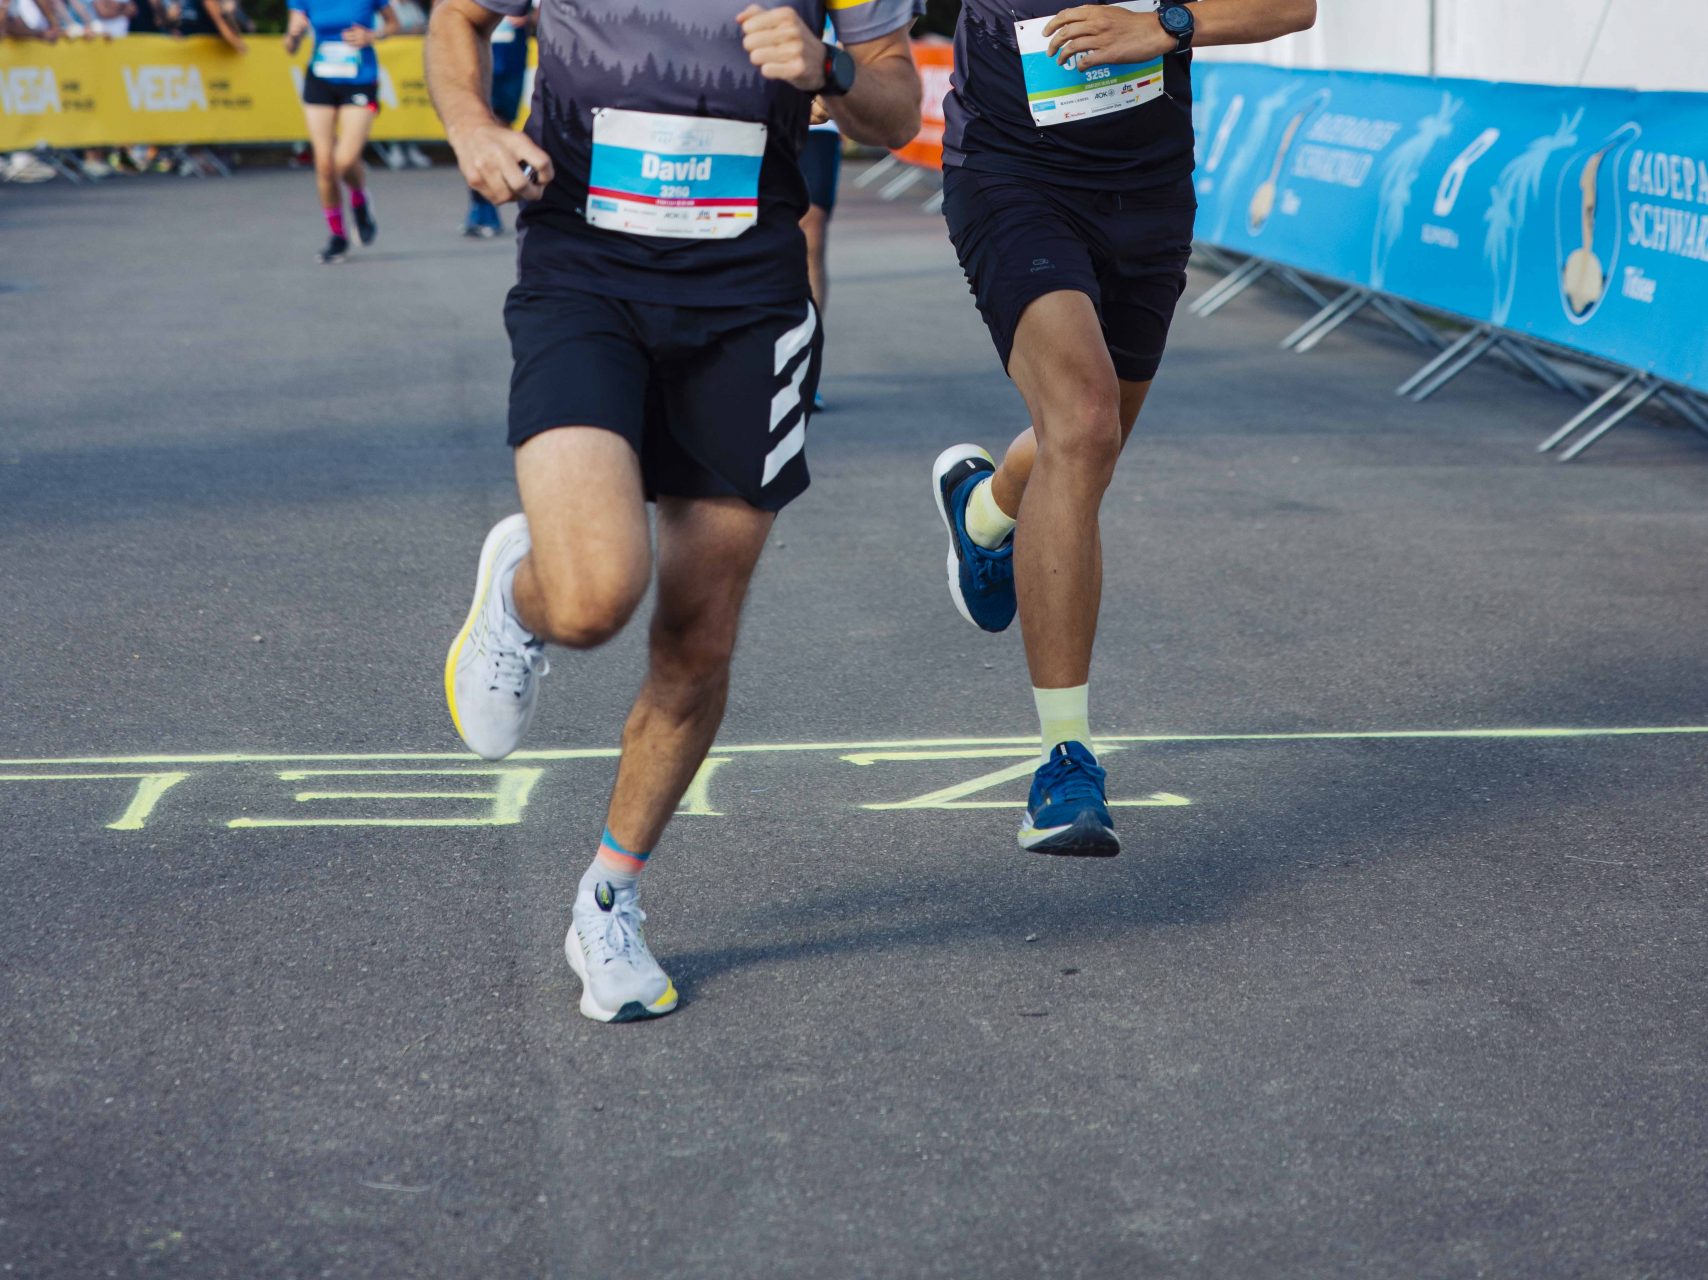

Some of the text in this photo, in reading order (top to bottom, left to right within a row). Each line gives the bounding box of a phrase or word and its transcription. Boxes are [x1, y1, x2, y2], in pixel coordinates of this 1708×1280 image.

[120, 64, 208, 113] VEGA
[1085, 67, 1111, 81] 3255
[641, 152, 712, 181] David
